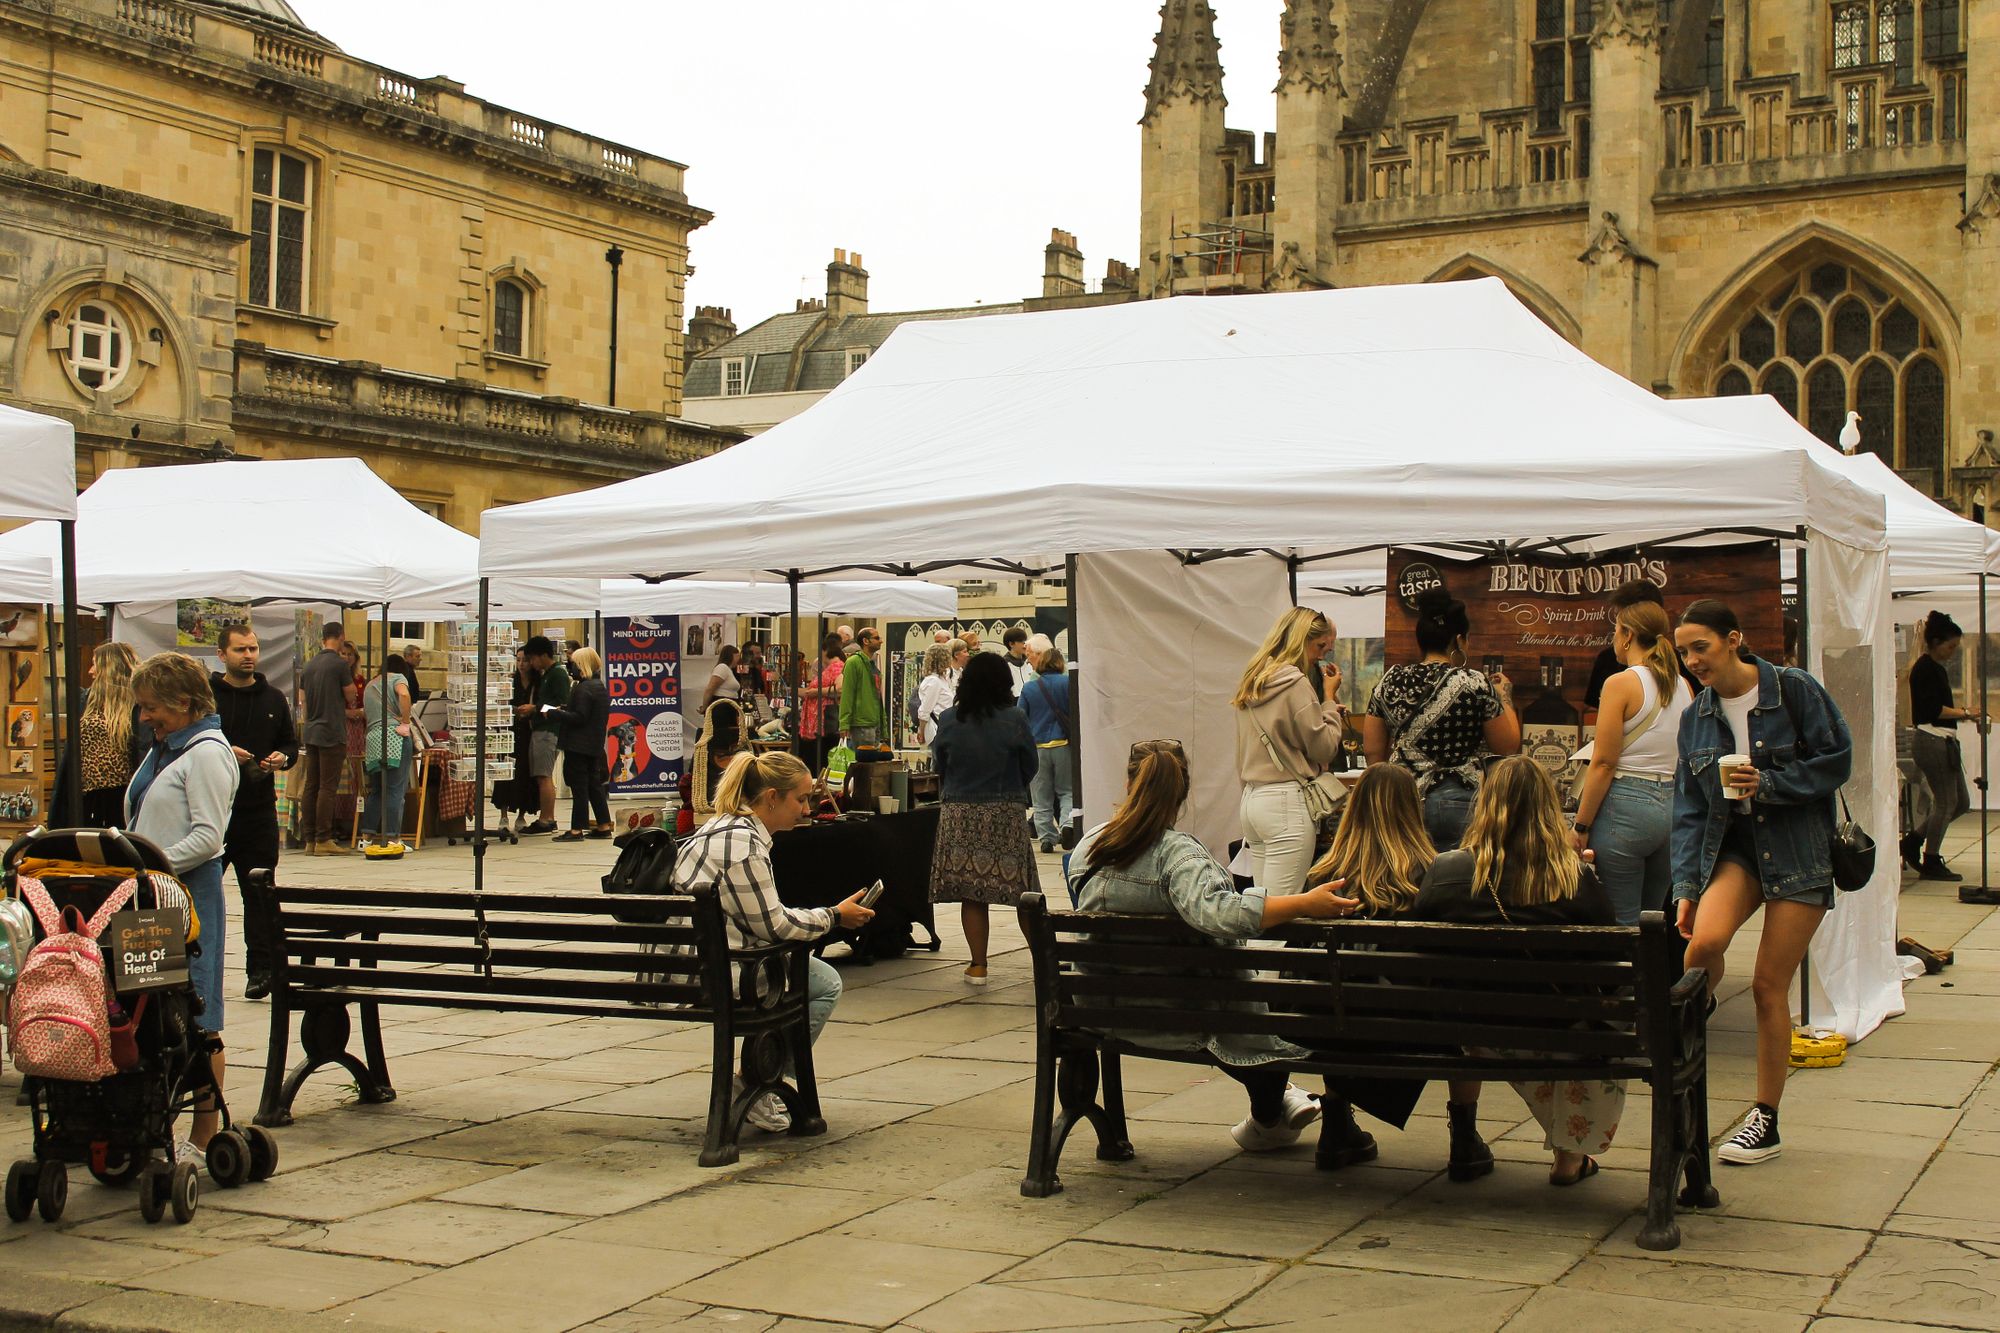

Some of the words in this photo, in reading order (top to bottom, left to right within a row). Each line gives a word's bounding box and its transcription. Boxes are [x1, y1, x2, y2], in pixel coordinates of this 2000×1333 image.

[1407, 569, 1430, 582] great
[1489, 558, 1668, 595] BECKFORD'S
[1400, 579, 1441, 597] taste
[1543, 607, 1572, 624] Spirit
[1575, 607, 1605, 622] Drink
[613, 630, 634, 638] MIND
[635, 630, 649, 638] THE
[1516, 632, 1554, 645] Blended
[1556, 637, 1566, 645] in
[1567, 634, 1580, 646] the
[1580, 634, 1609, 647] British
[608, 652, 676, 661] HANDMADE
[608, 662, 677, 678] HAPPY
[609, 677, 678, 697] DOG
[610, 697, 677, 706] ACCESSORIES
[122, 928, 145, 939] Get
[149, 925, 172, 937] The
[122, 939, 163, 950] Fudge
[123, 951, 147, 963] Out
[150, 948, 166, 961] Of
[124, 961, 157, 975] Here!
